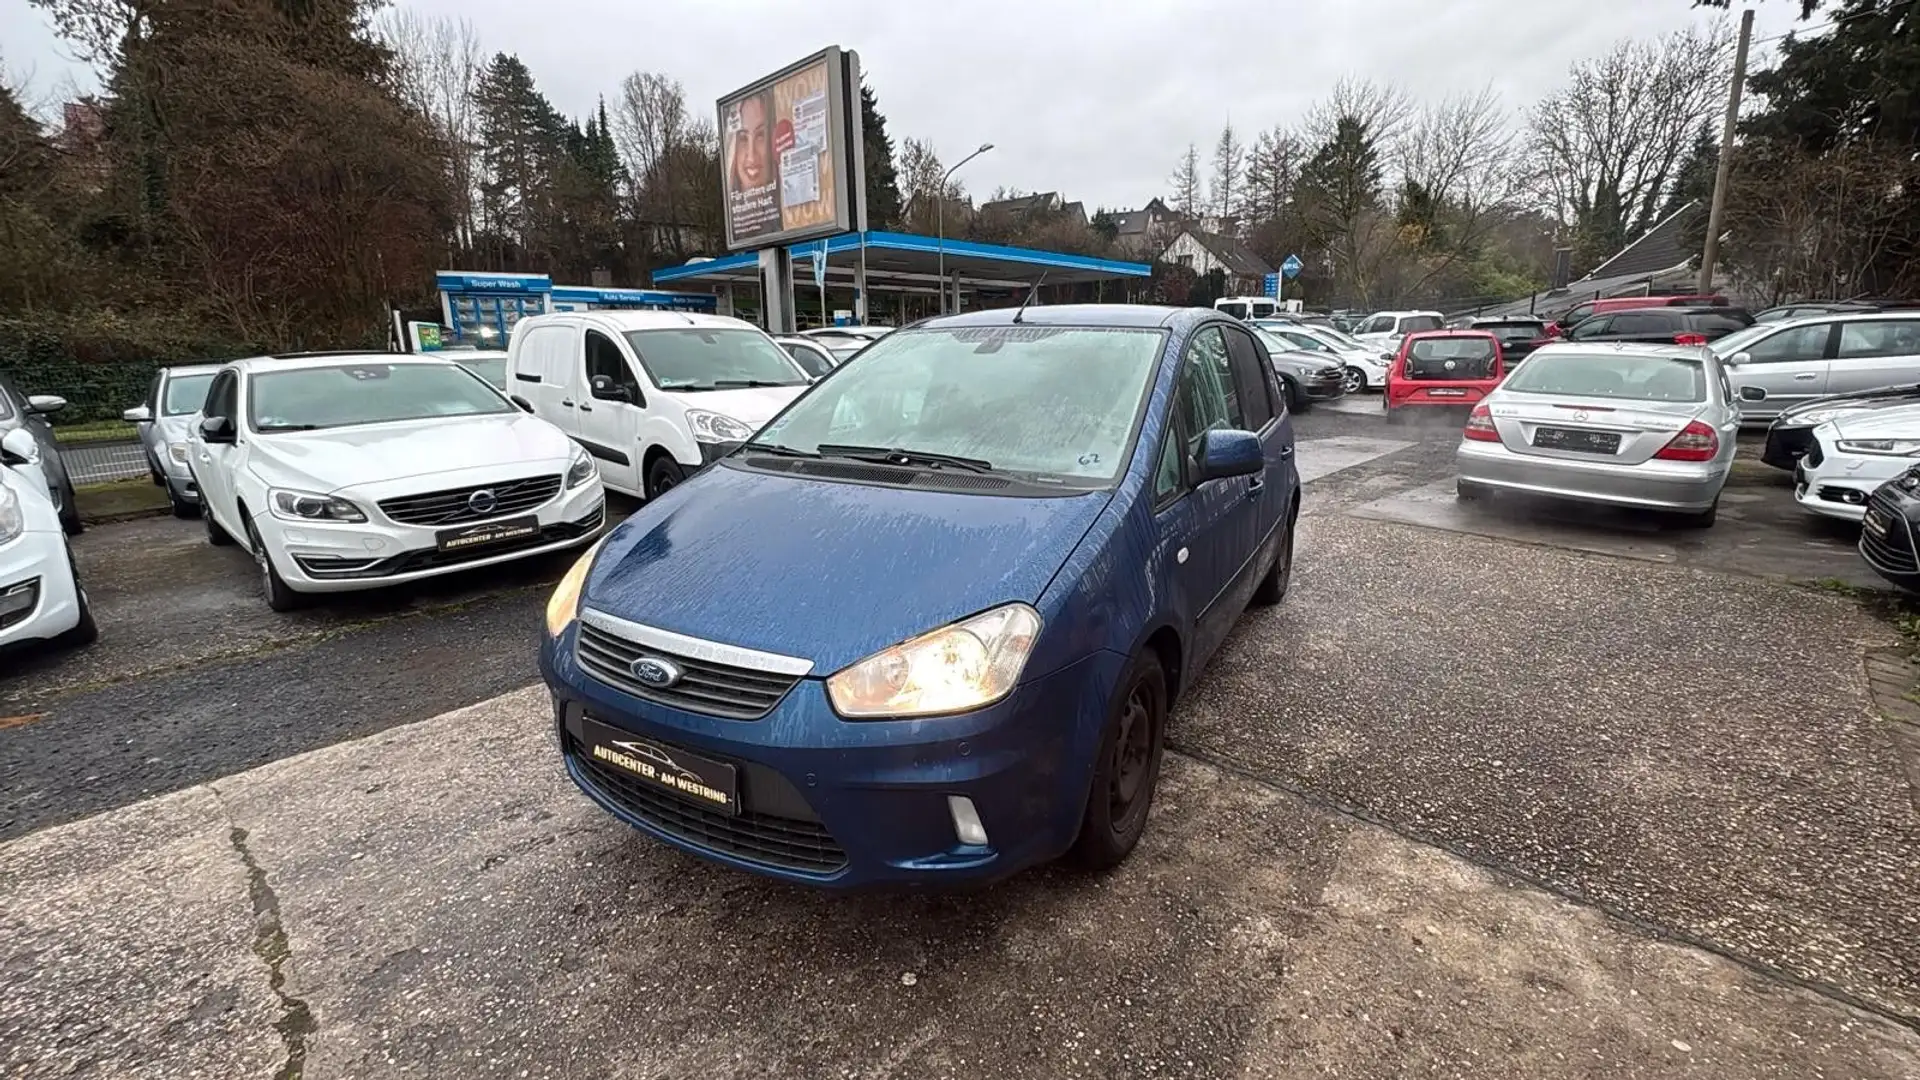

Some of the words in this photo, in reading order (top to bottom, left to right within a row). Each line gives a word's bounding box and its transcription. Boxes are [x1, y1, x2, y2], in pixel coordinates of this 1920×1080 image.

[471, 279, 497, 290] Super
[498, 279, 521, 289] Wash
[604, 292, 617, 301] Auto
[617, 293, 641, 302] Service
[673, 296, 685, 304] Auto
[446, 534, 492, 548] AUTOCENTER
[638, 663, 662, 682] Ford
[593, 744, 655, 779] AUTOCENTER
[661, 772, 676, 786] AM
[677, 777, 727, 804] WESTRING
